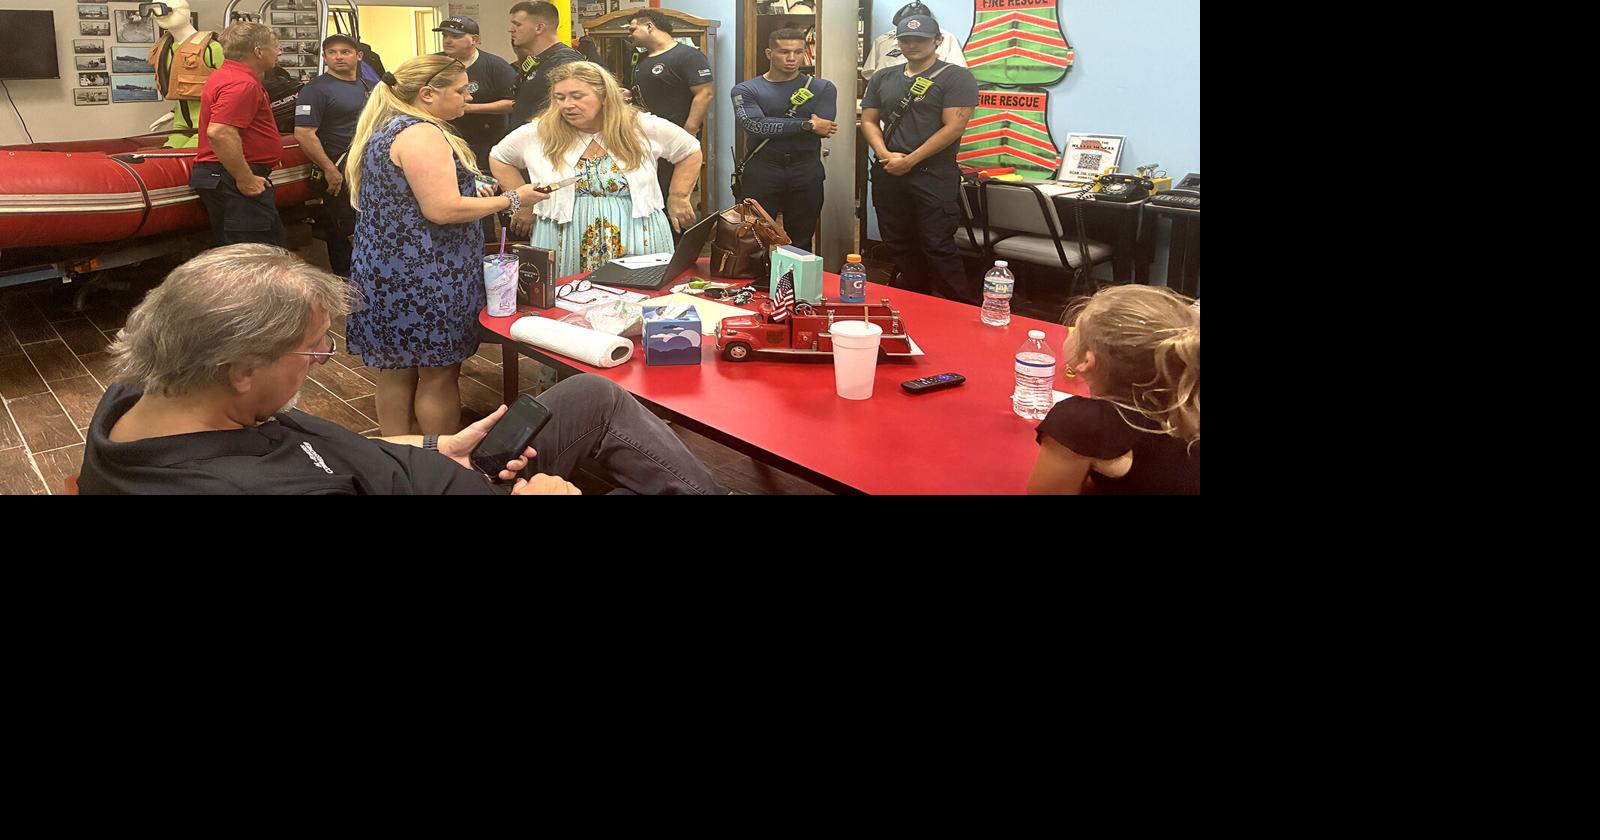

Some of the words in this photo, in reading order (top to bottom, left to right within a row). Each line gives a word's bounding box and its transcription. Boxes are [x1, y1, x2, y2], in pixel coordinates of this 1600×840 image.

[983, 0, 1005, 8] FIRE
[271, 92, 298, 108] CURY
[1000, 96, 1040, 107] RESCUE
[743, 119, 783, 134] RESCUE
[853, 280, 863, 289] G
